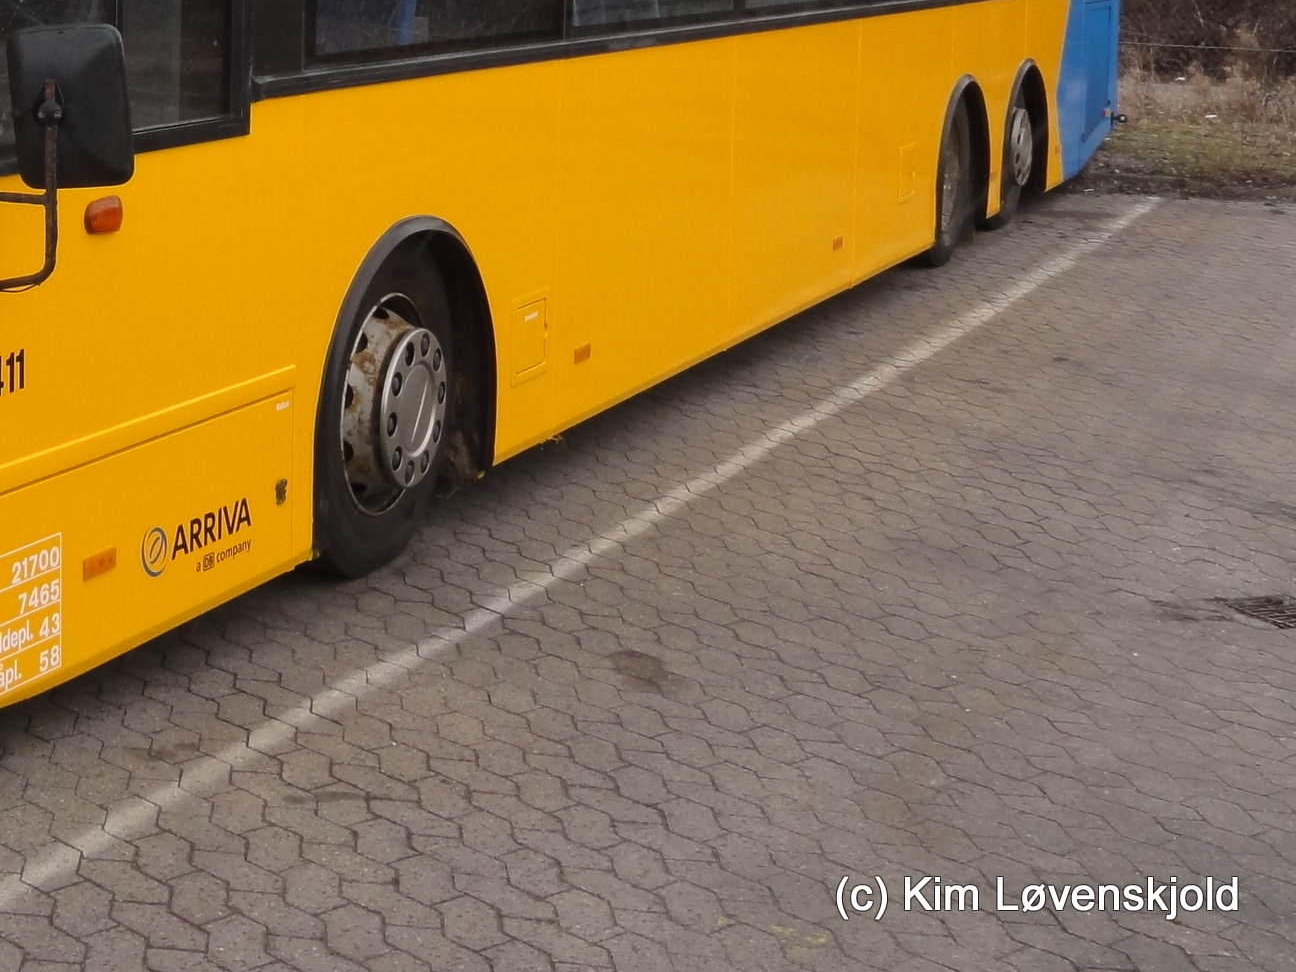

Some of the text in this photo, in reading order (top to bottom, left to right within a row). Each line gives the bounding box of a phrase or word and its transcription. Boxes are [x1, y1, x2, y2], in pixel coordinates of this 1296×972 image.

[171, 497, 252, 561] ARRIVA
[11, 546, 60, 585] 21700
[195, 562, 201, 572] a
[216, 538, 252, 563] company
[18, 579, 60, 615] 7465
[39, 613, 60, 638] 43
[39, 645, 60, 673] 58
